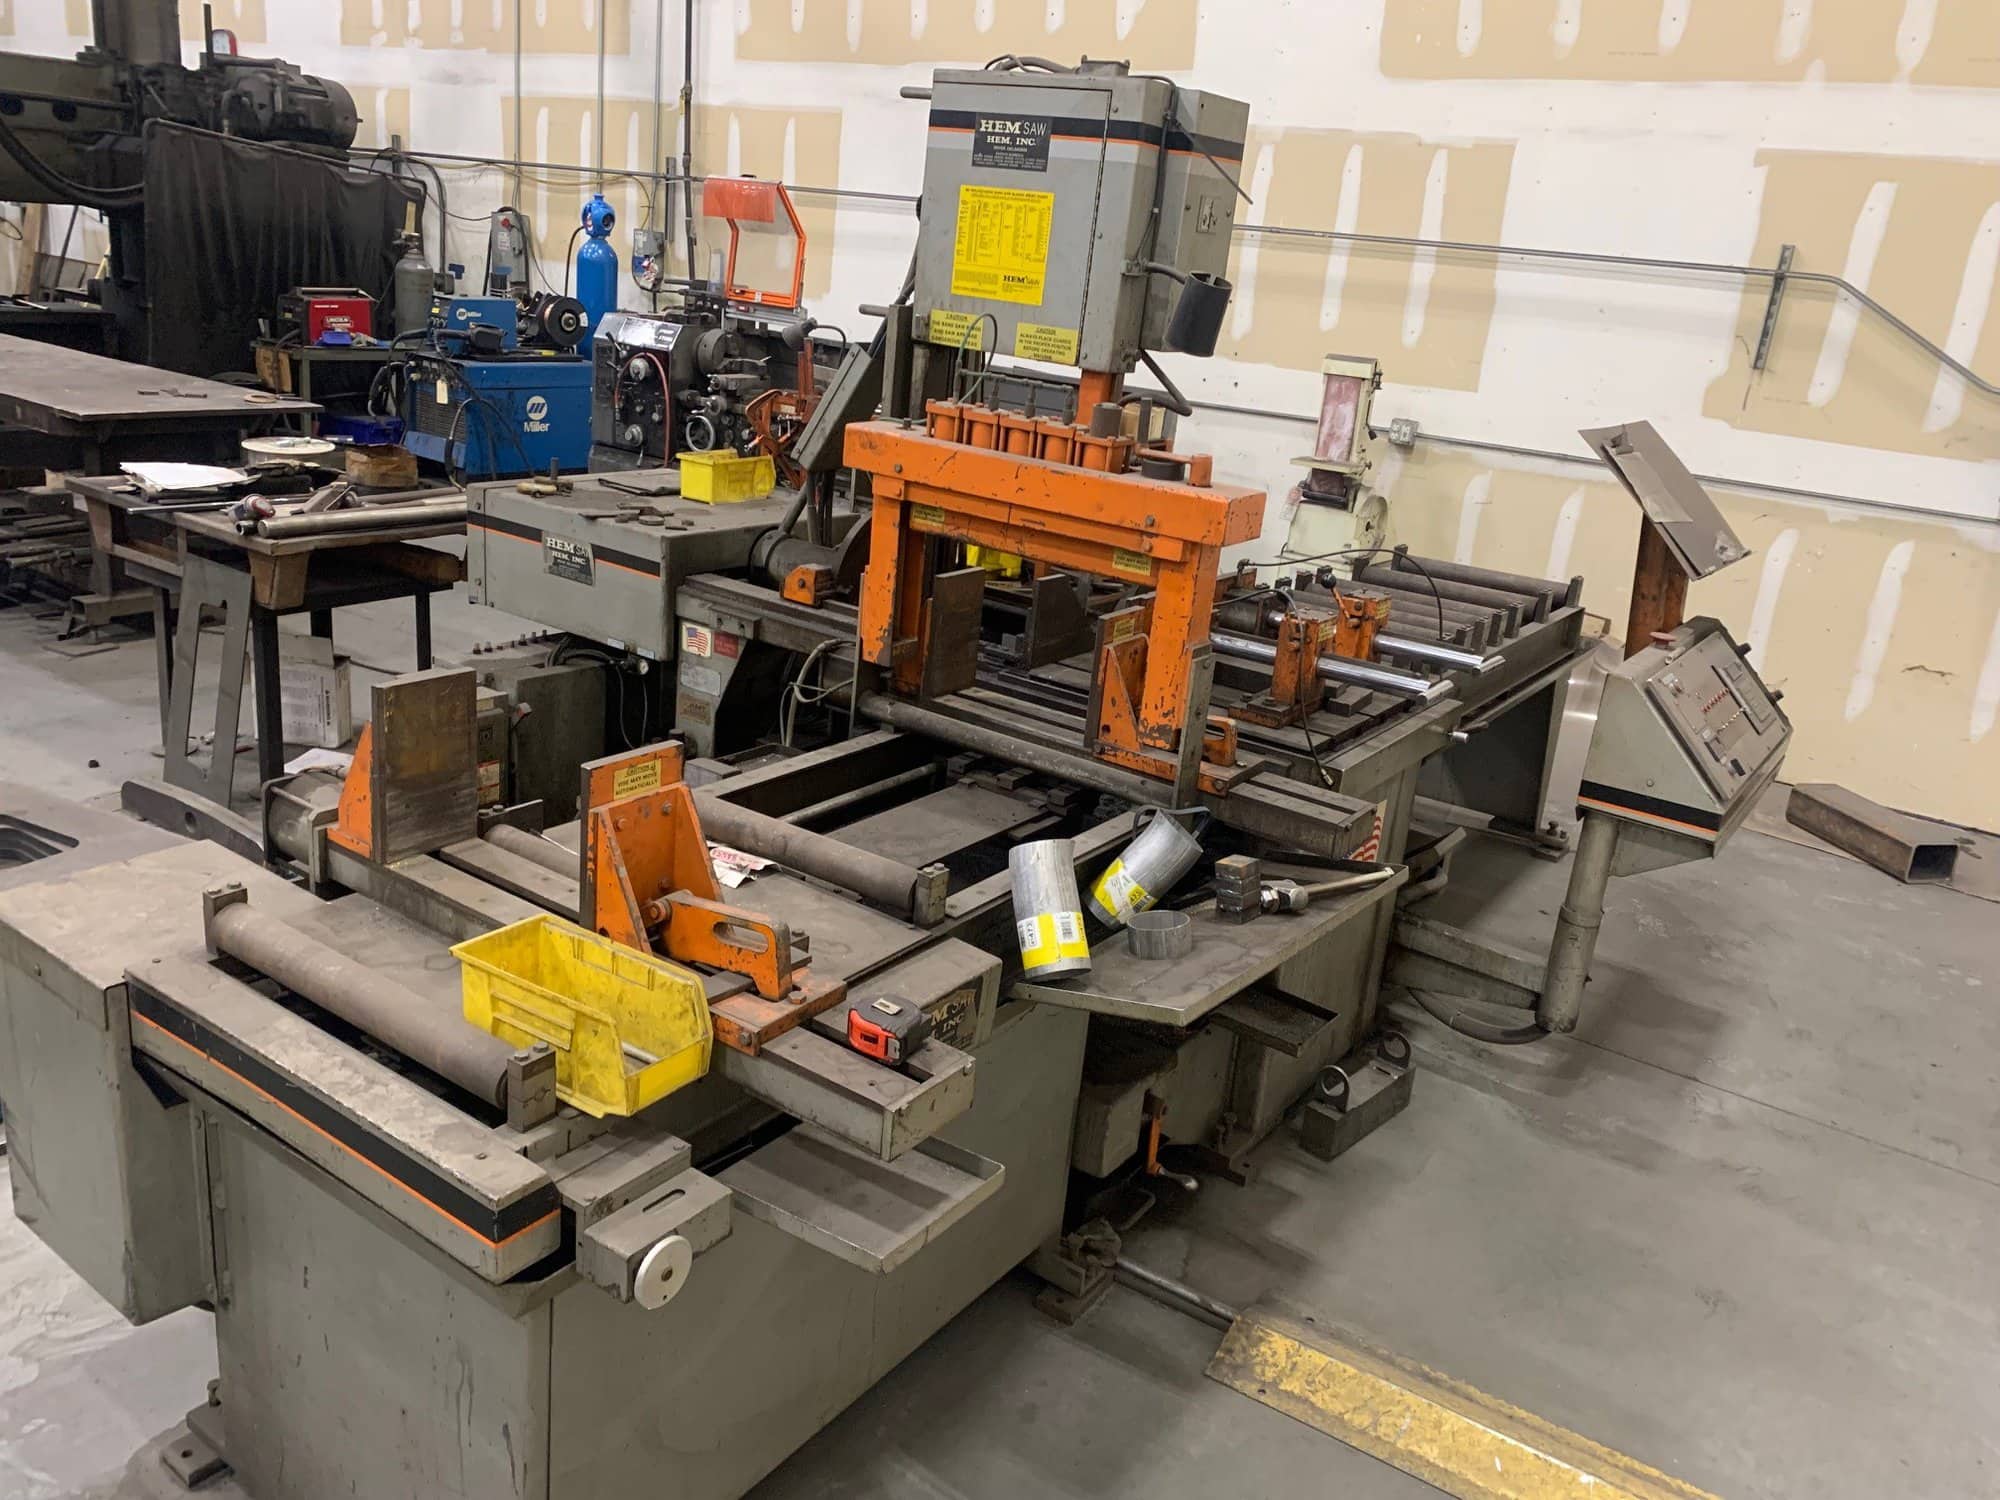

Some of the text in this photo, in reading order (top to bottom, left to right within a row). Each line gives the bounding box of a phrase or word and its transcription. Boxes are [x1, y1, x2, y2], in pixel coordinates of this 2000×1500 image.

[980, 119, 1047, 136] HEM SAW
[523, 420, 551, 433] Miller
[546, 537, 575, 554] HEM
